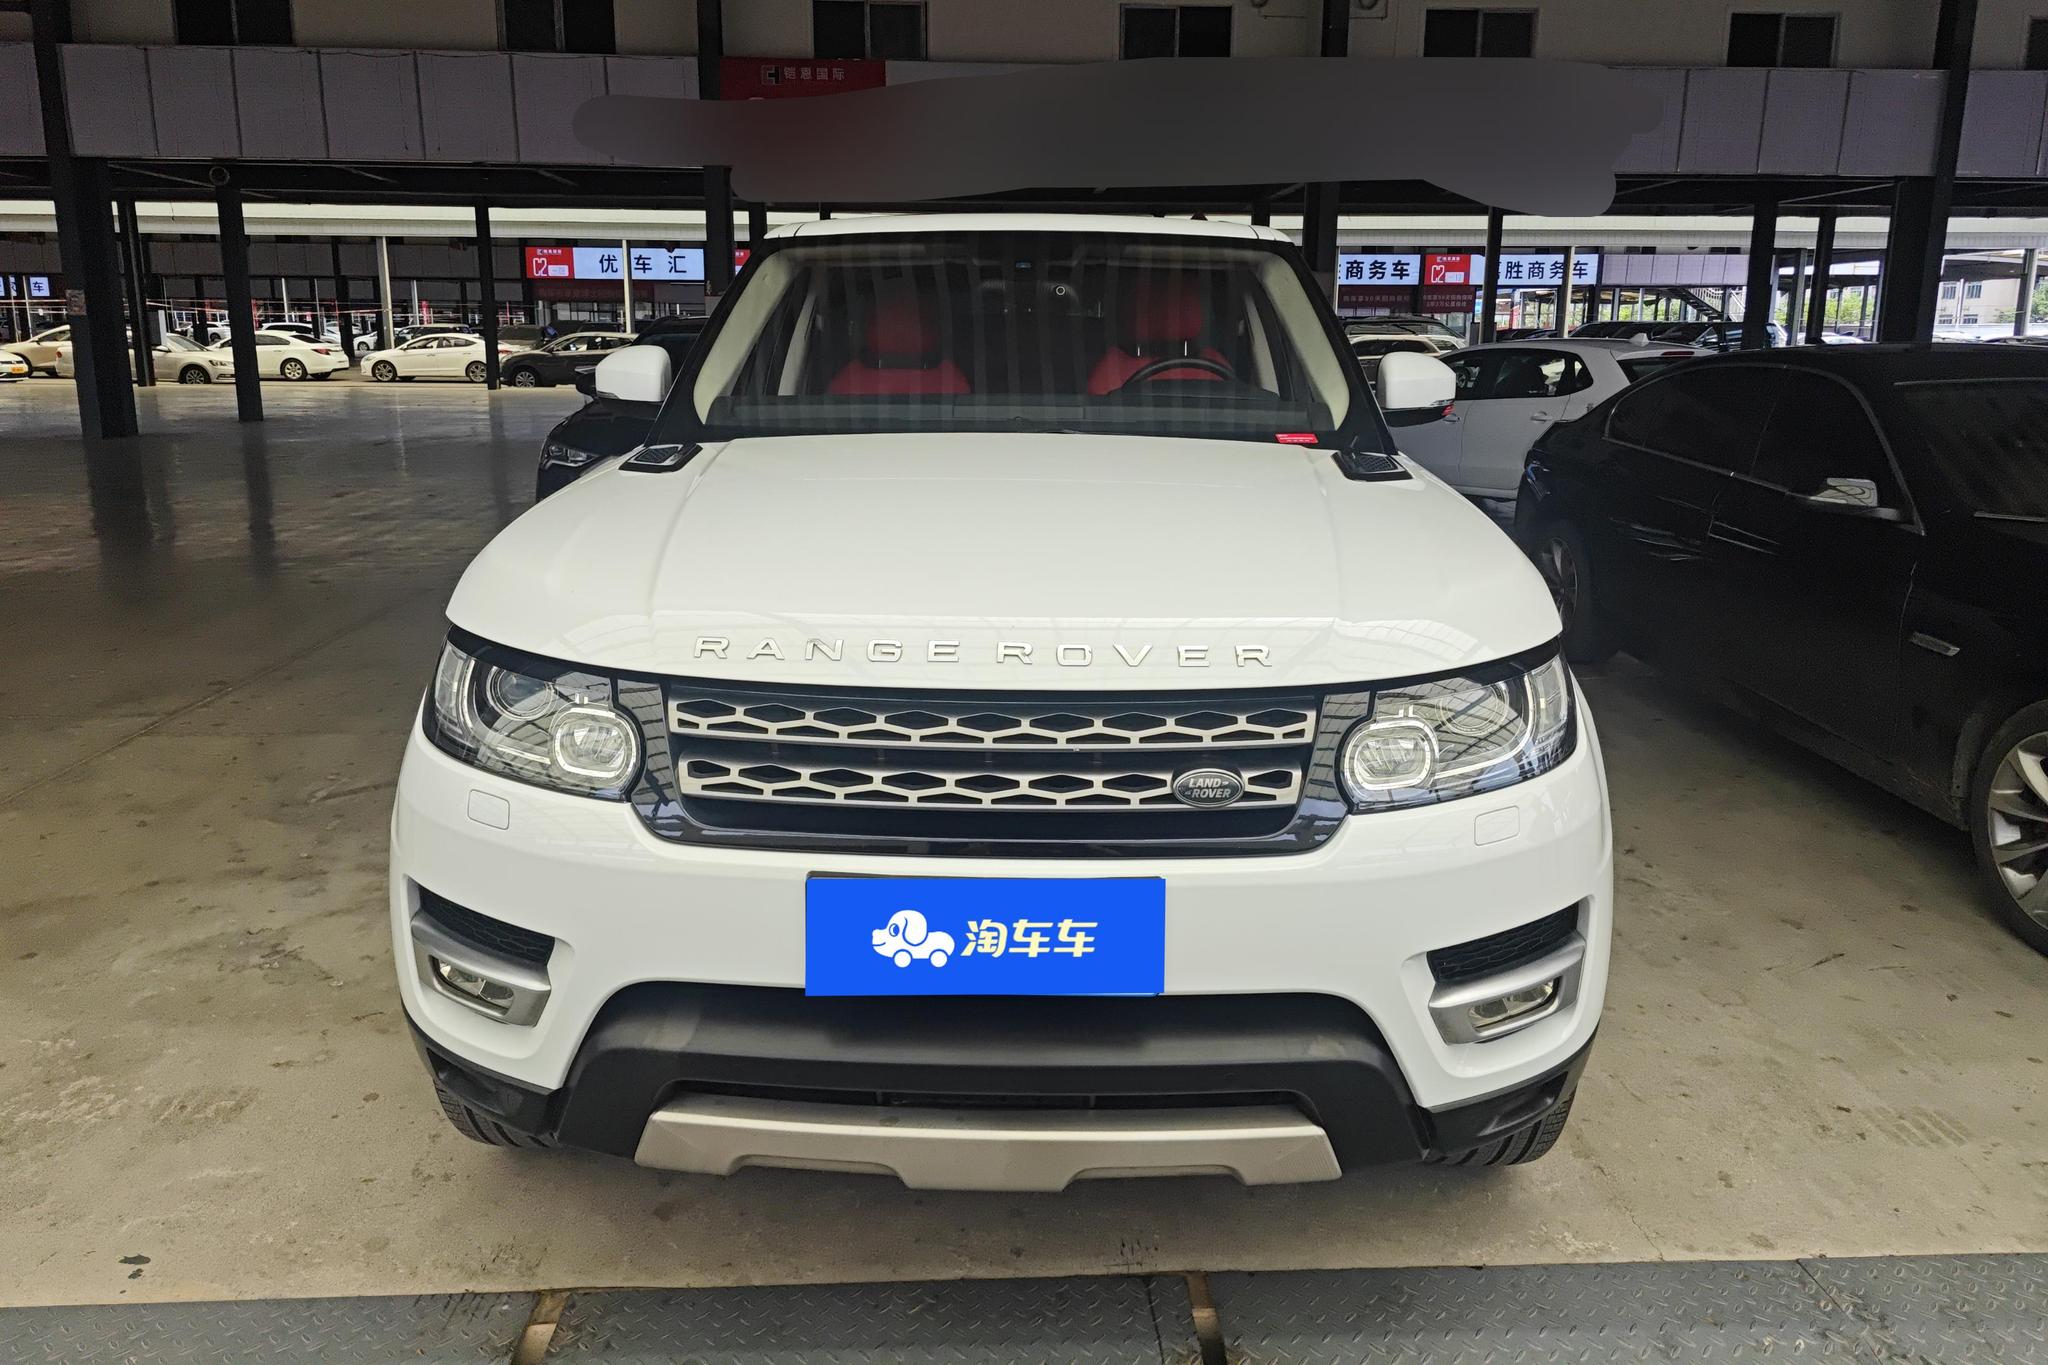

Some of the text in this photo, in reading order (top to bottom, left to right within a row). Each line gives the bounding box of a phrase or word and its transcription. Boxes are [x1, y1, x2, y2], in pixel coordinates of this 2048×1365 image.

[598, 254, 688, 274] 优车汇
[1338, 259, 1410, 280] 商务车
[1497, 260, 1589, 280] 胜商务车
[693, 636, 1273, 668] RANGE ROVER
[1189, 777, 1222, 788] LAND
[1191, 788, 1232, 798] ROVER
